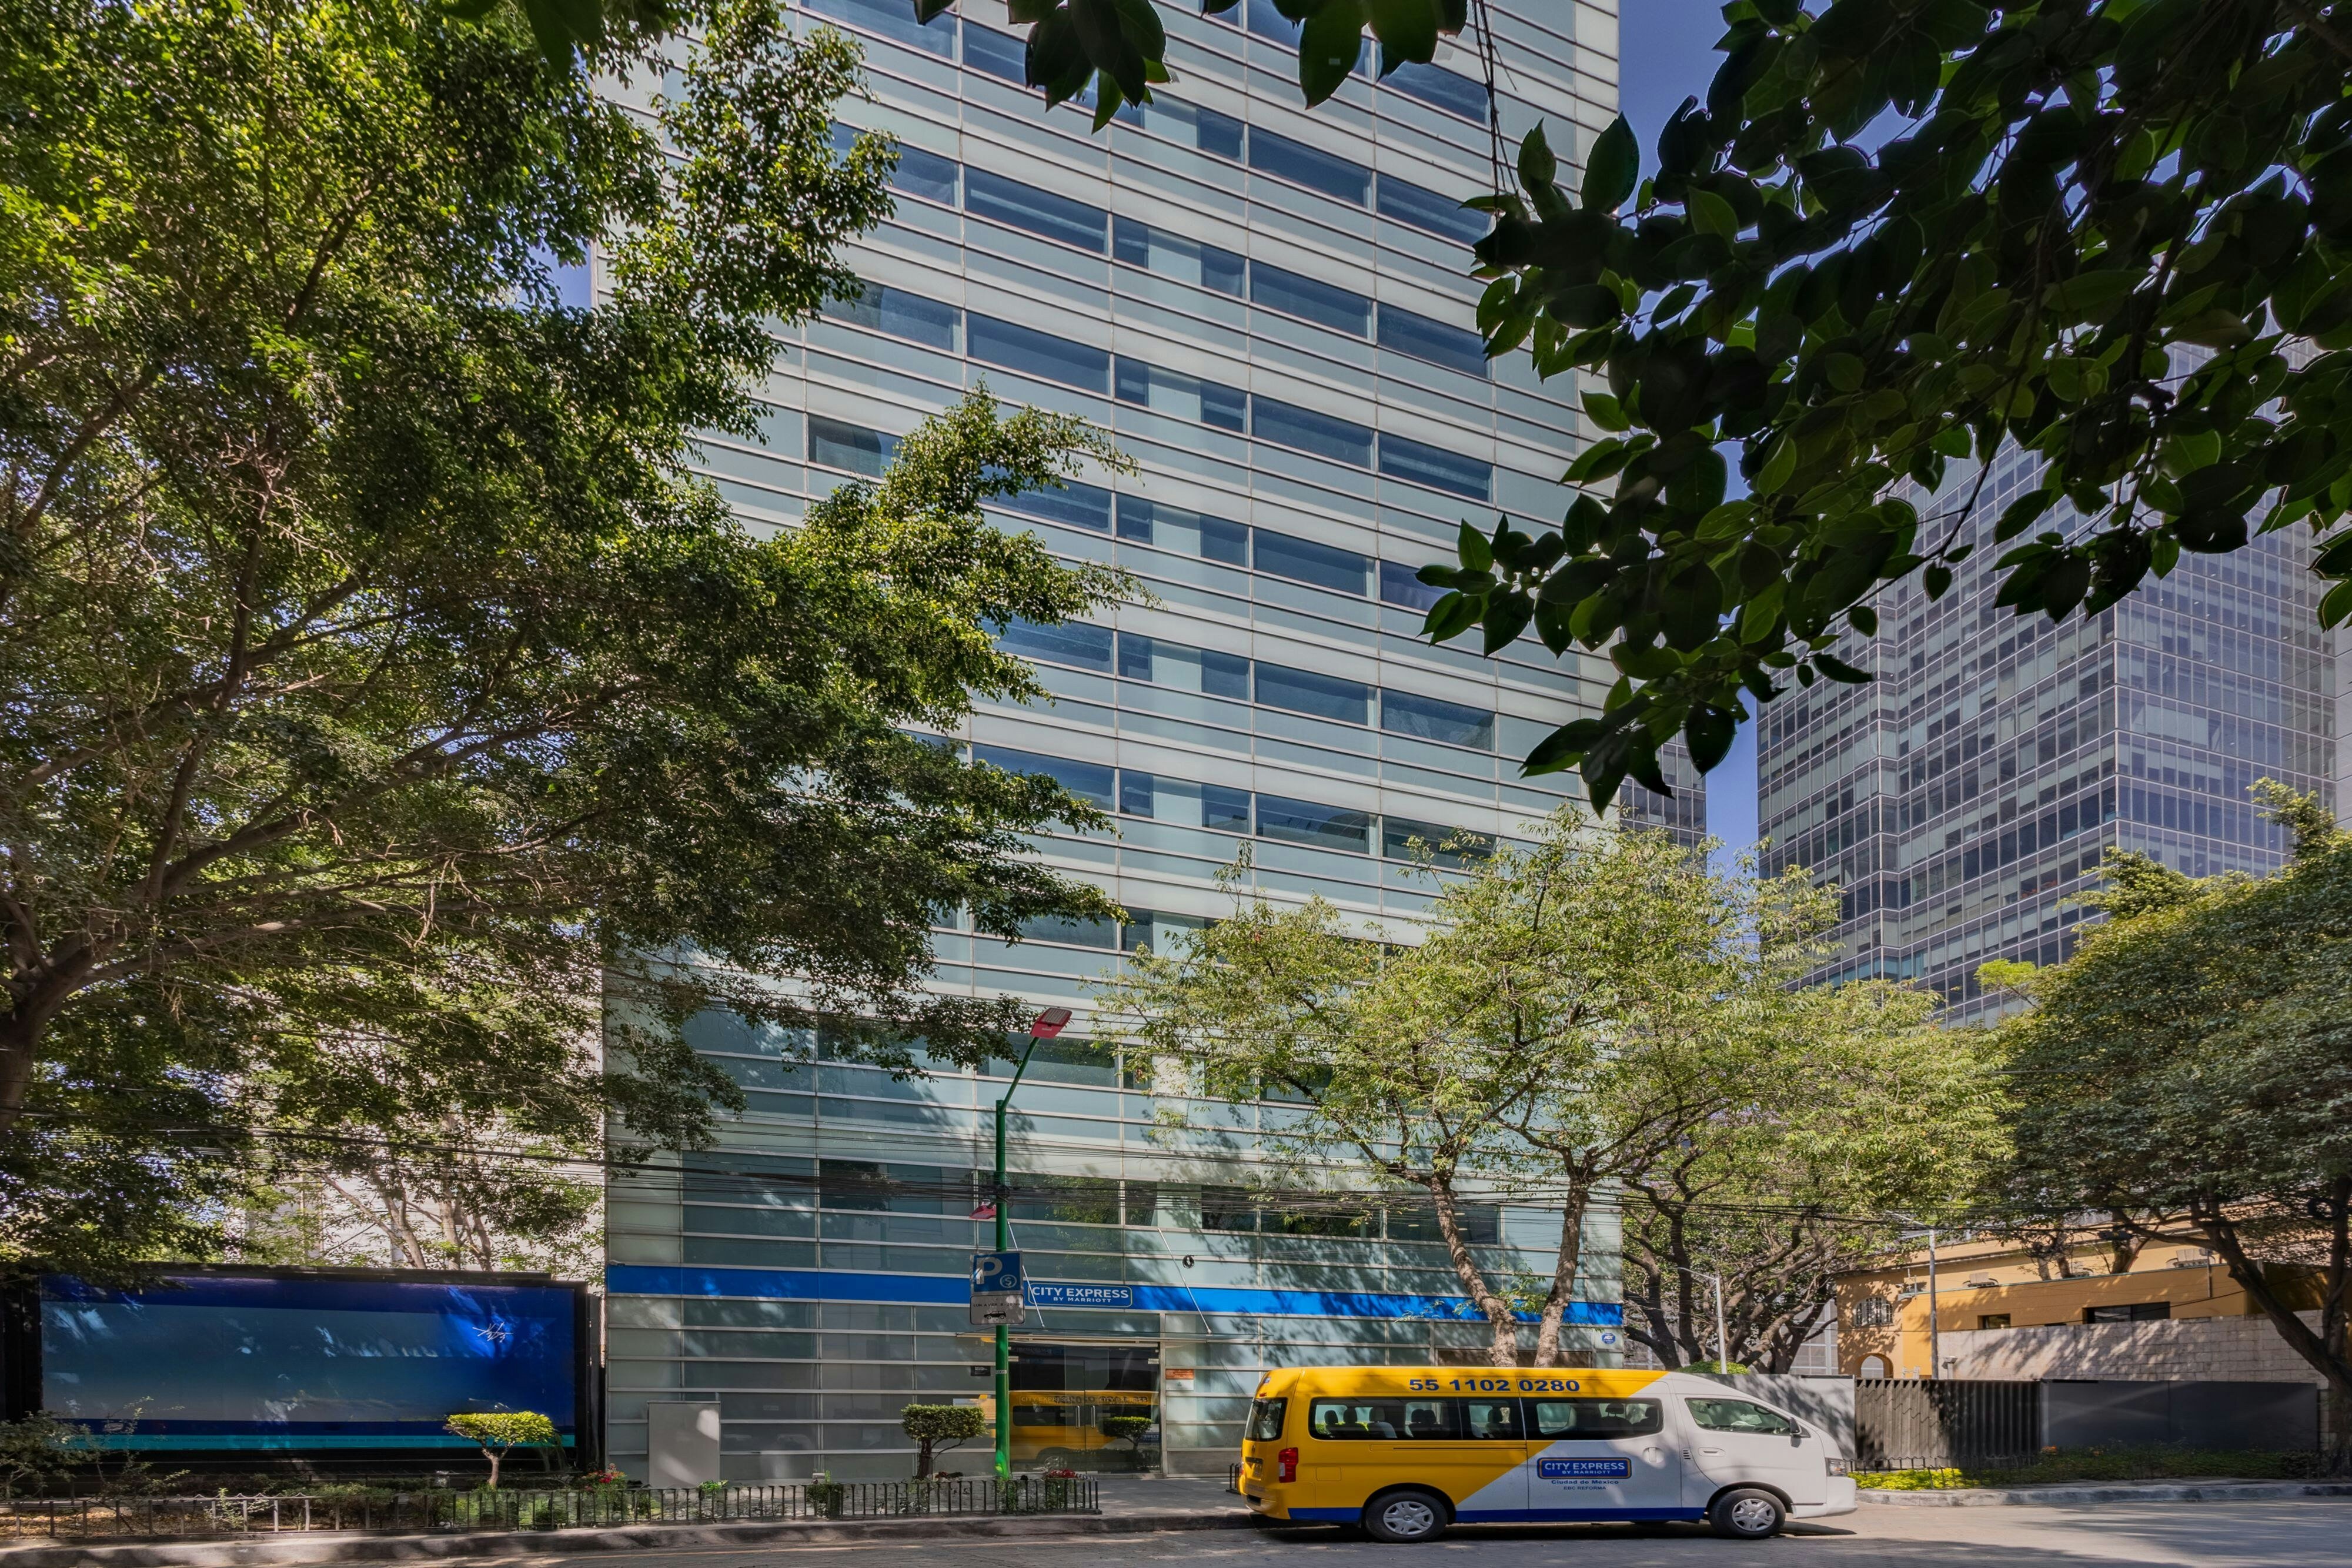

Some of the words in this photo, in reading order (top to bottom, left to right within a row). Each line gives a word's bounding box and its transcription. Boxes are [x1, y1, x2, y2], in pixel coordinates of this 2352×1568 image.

[976, 1256, 1003, 1285] P
[1032, 1287, 1062, 1296] CITY
[1066, 1288, 1129, 1299] EXPRESS
[1409, 1379, 1439, 1391] 55
[1449, 1379, 1511, 1391] 1102
[1519, 1379, 1580, 1392] 0280
